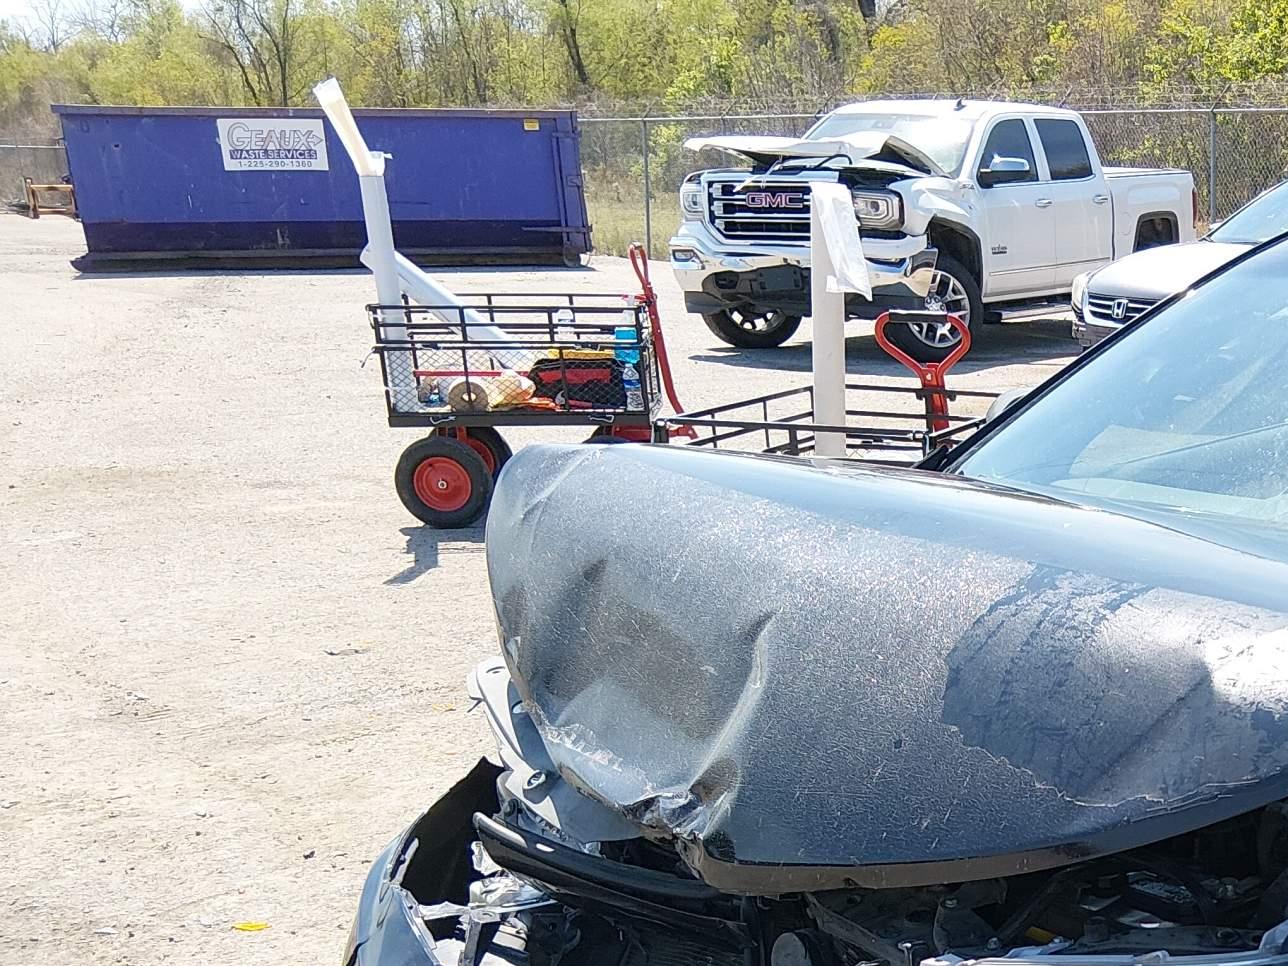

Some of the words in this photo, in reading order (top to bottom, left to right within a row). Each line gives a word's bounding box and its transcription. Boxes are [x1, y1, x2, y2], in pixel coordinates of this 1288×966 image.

[227, 122, 314, 150] GEAUX
[231, 150, 266, 159] WASTE
[268, 150, 317, 159] SERVICES
[746, 192, 804, 208] GMC
